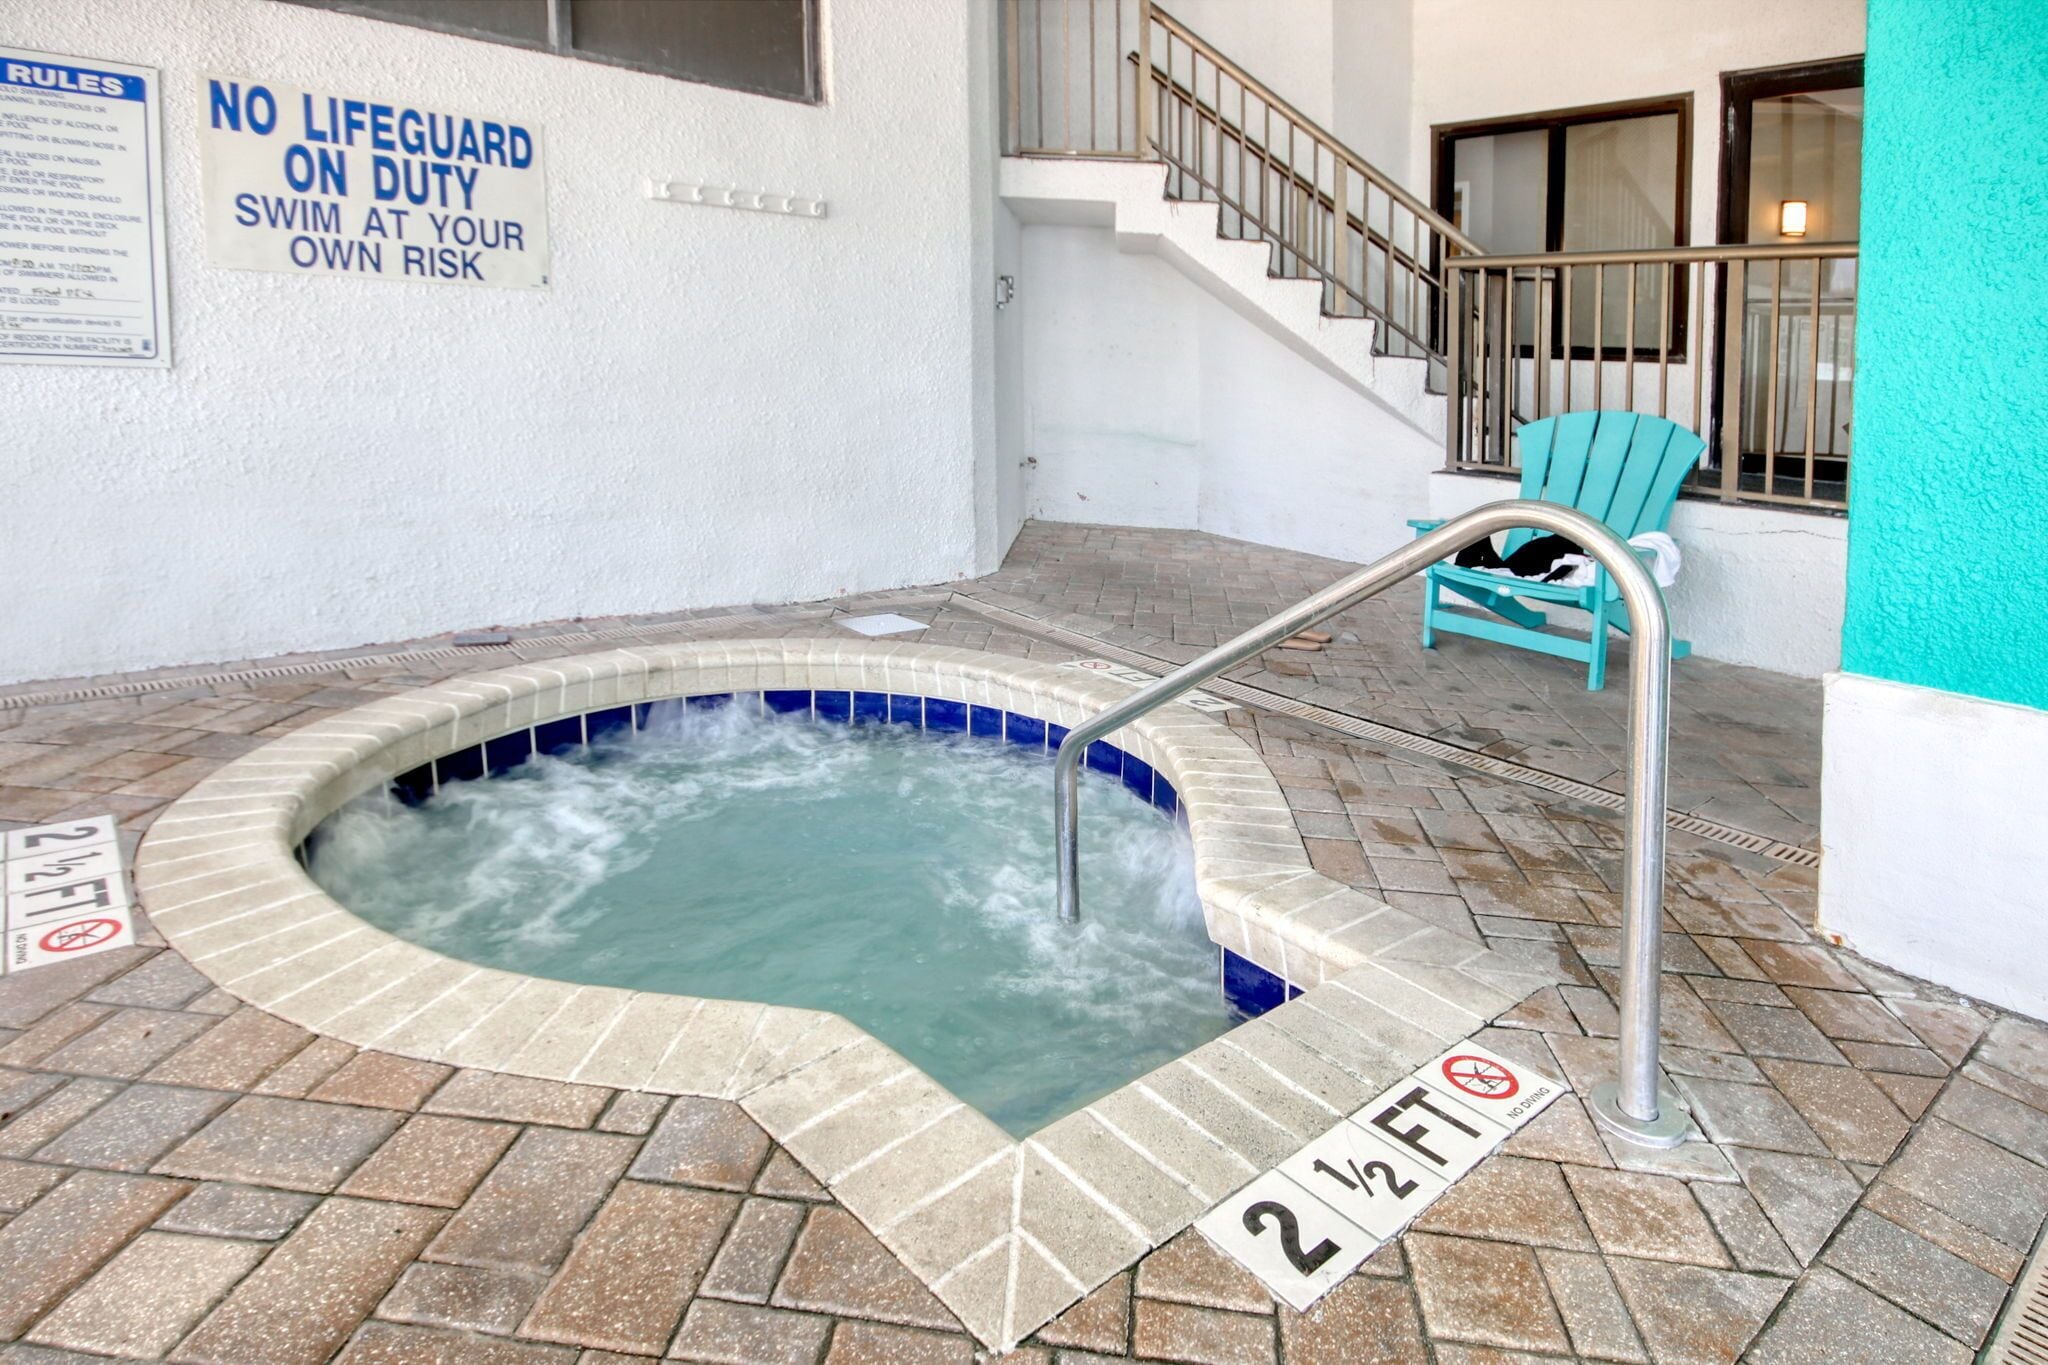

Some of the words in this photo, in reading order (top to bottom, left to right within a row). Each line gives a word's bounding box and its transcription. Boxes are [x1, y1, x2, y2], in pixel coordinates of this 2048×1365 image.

[6, 63, 125, 96] RULES
[51, 118, 62, 126] OF
[66, 121, 103, 132] ALCOHOL
[106, 125, 119, 133] OR
[208, 78, 277, 136] NO
[302, 92, 534, 170] LIFEGUARD
[52, 136, 90, 148] BLOWING
[93, 141, 115, 150] NOSE
[16, 151, 50, 160] ILLNESS
[68, 156, 102, 166] NAUSEA
[10, 176, 40, 185] ENTER
[41, 179, 58, 188] THE
[12, 168, 30, 178] EAR
[32, 170, 46, 178] OR
[48, 172, 105, 184] RESPIRATORY
[283, 143, 348, 197] ON
[371, 153, 480, 211] DUTY
[32, 188, 46, 196] OR
[48, 190, 86, 200] WOUNDS
[88, 193, 122, 204] SHOULD
[48, 207, 65, 216] THE
[67, 209, 90, 218] POOL
[20, 214, 43, 224] POOL
[46, 216, 59, 224] OR
[61, 218, 74, 226] ON
[76, 219, 92, 228] THE
[234, 192, 342, 235] SWIM
[363, 206, 409, 240] AT
[428, 212, 525, 252] YOUR
[24, 224, 40, 232] THE
[43, 225, 68, 235] POOL
[69, 228, 107, 238] WITHOUT
[31, 242, 66, 253] BEFORE
[68, 246, 112, 256] ENTERING
[112, 248, 128, 257] THE
[289, 235, 382, 274] OWN
[403, 244, 486, 281] RISK
[18, 270, 64, 280] SWIMMERS
[67, 274, 108, 282] ALLOWED
[10, 296, 18, 304] IS
[20, 296, 60, 306] LOCATED
[13, 333, 50, 342] RECORD
[86, 336, 121, 344] FACILITY
[25, 878, 111, 917] FT
[1506, 1107, 1524, 1120] NO
[1520, 1087, 1551, 1109] DIVING
[1242, 1200, 1342, 1278] 2
[1370, 1086, 1482, 1167] FT
